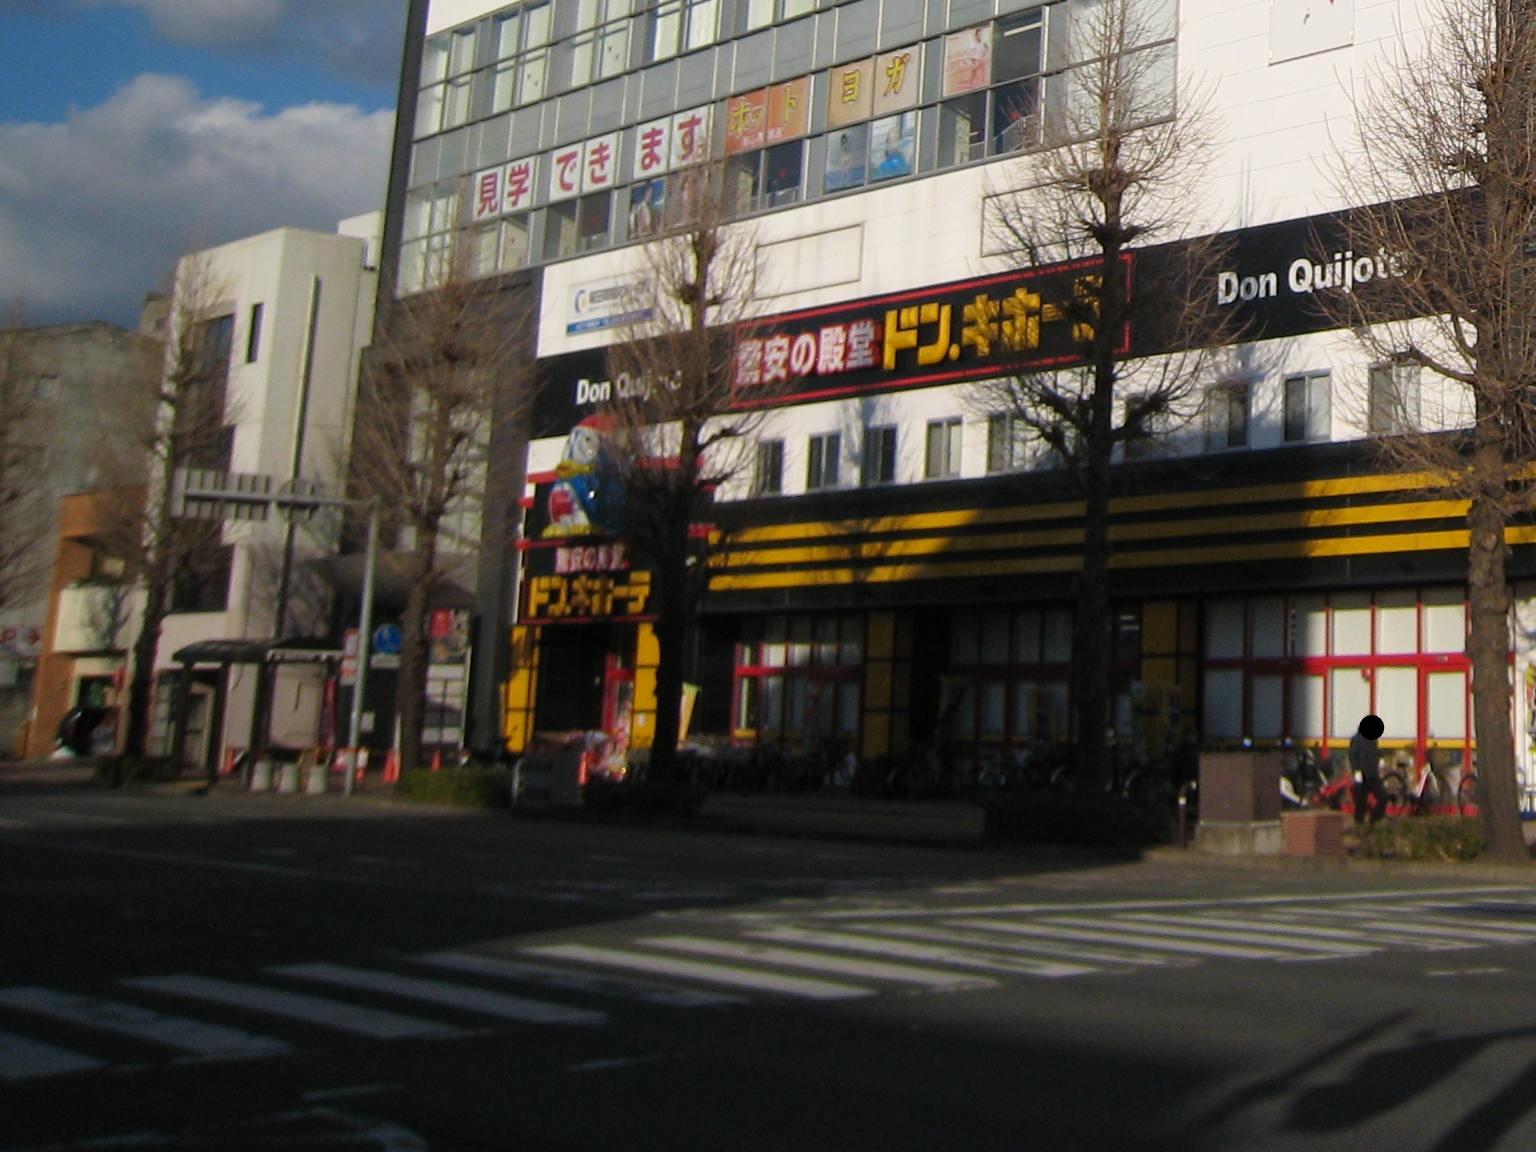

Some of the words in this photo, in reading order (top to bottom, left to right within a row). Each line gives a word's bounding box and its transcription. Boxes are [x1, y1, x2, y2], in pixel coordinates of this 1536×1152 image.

[476, 113, 704, 216] 見学できます
[1217, 270, 1277, 305] Don
[1288, 247, 1409, 294] Quijote
[575, 378, 611, 405] Don
